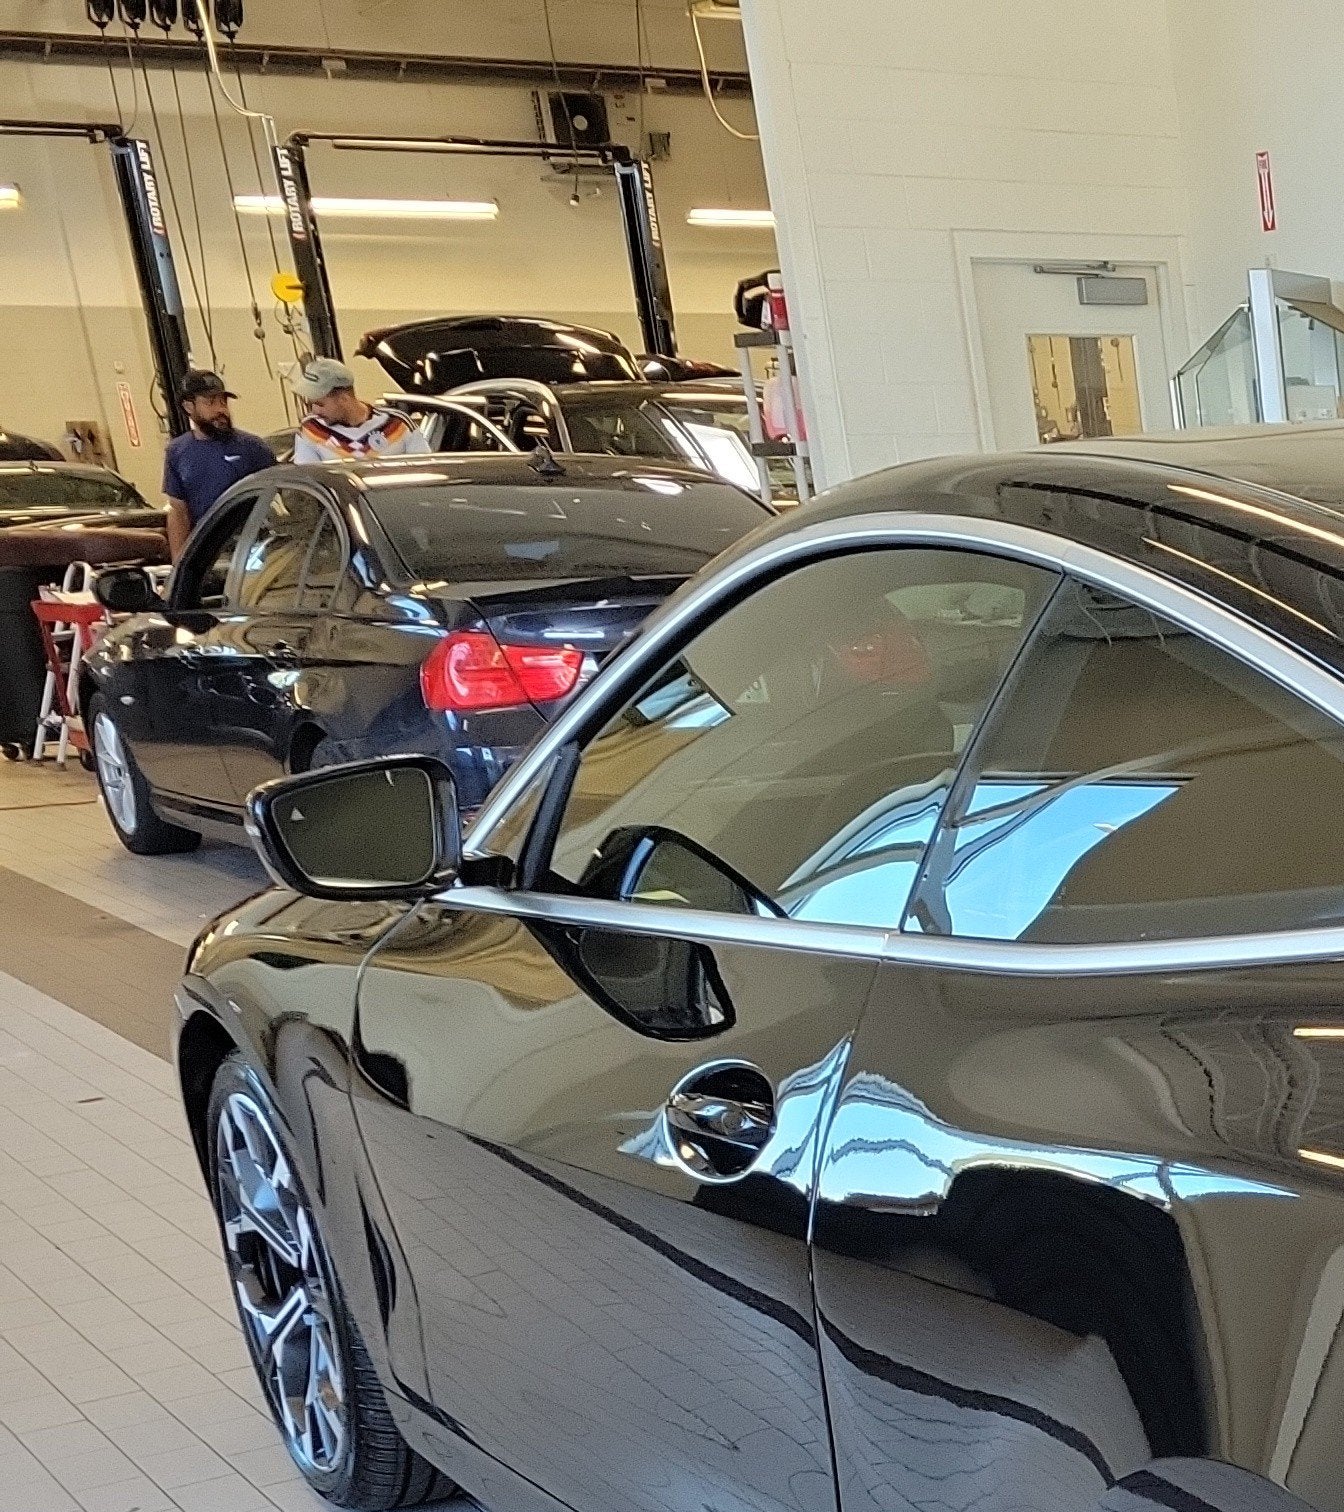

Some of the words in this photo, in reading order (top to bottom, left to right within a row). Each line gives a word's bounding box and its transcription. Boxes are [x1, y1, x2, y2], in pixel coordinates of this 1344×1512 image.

[135, 139, 151, 171] LIFT
[276, 148, 294, 178] LIFT
[143, 172, 166, 229] ROTARY
[282, 179, 304, 232] ROTARY
